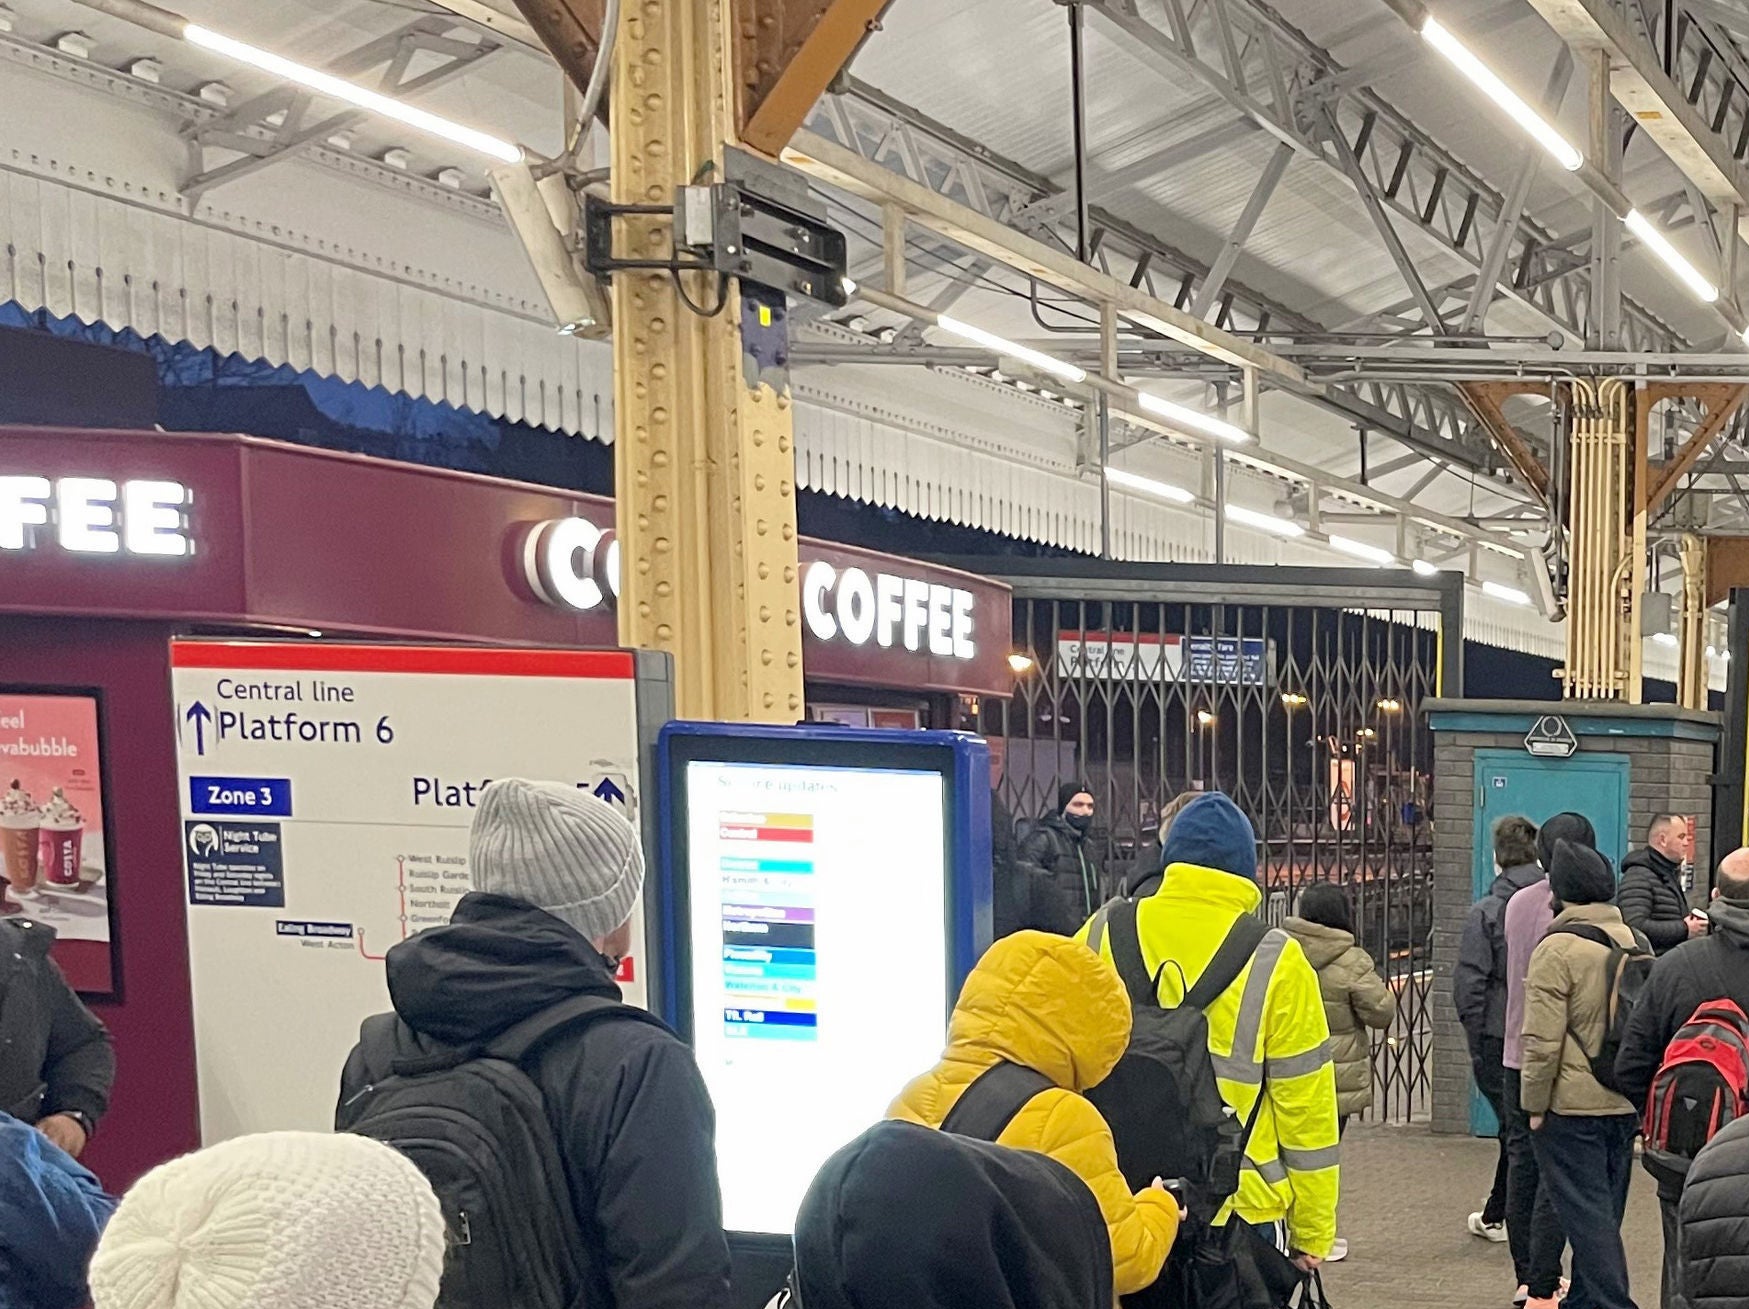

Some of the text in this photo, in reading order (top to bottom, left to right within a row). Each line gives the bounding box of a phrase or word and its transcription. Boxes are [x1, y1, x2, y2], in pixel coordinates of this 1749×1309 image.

[536, 516, 620, 610] C
[803, 560, 975, 660] COFFEE
[217, 678, 355, 703] Central line
[219, 711, 395, 745] Platform 6
[207, 786, 273, 806] Zone 3
